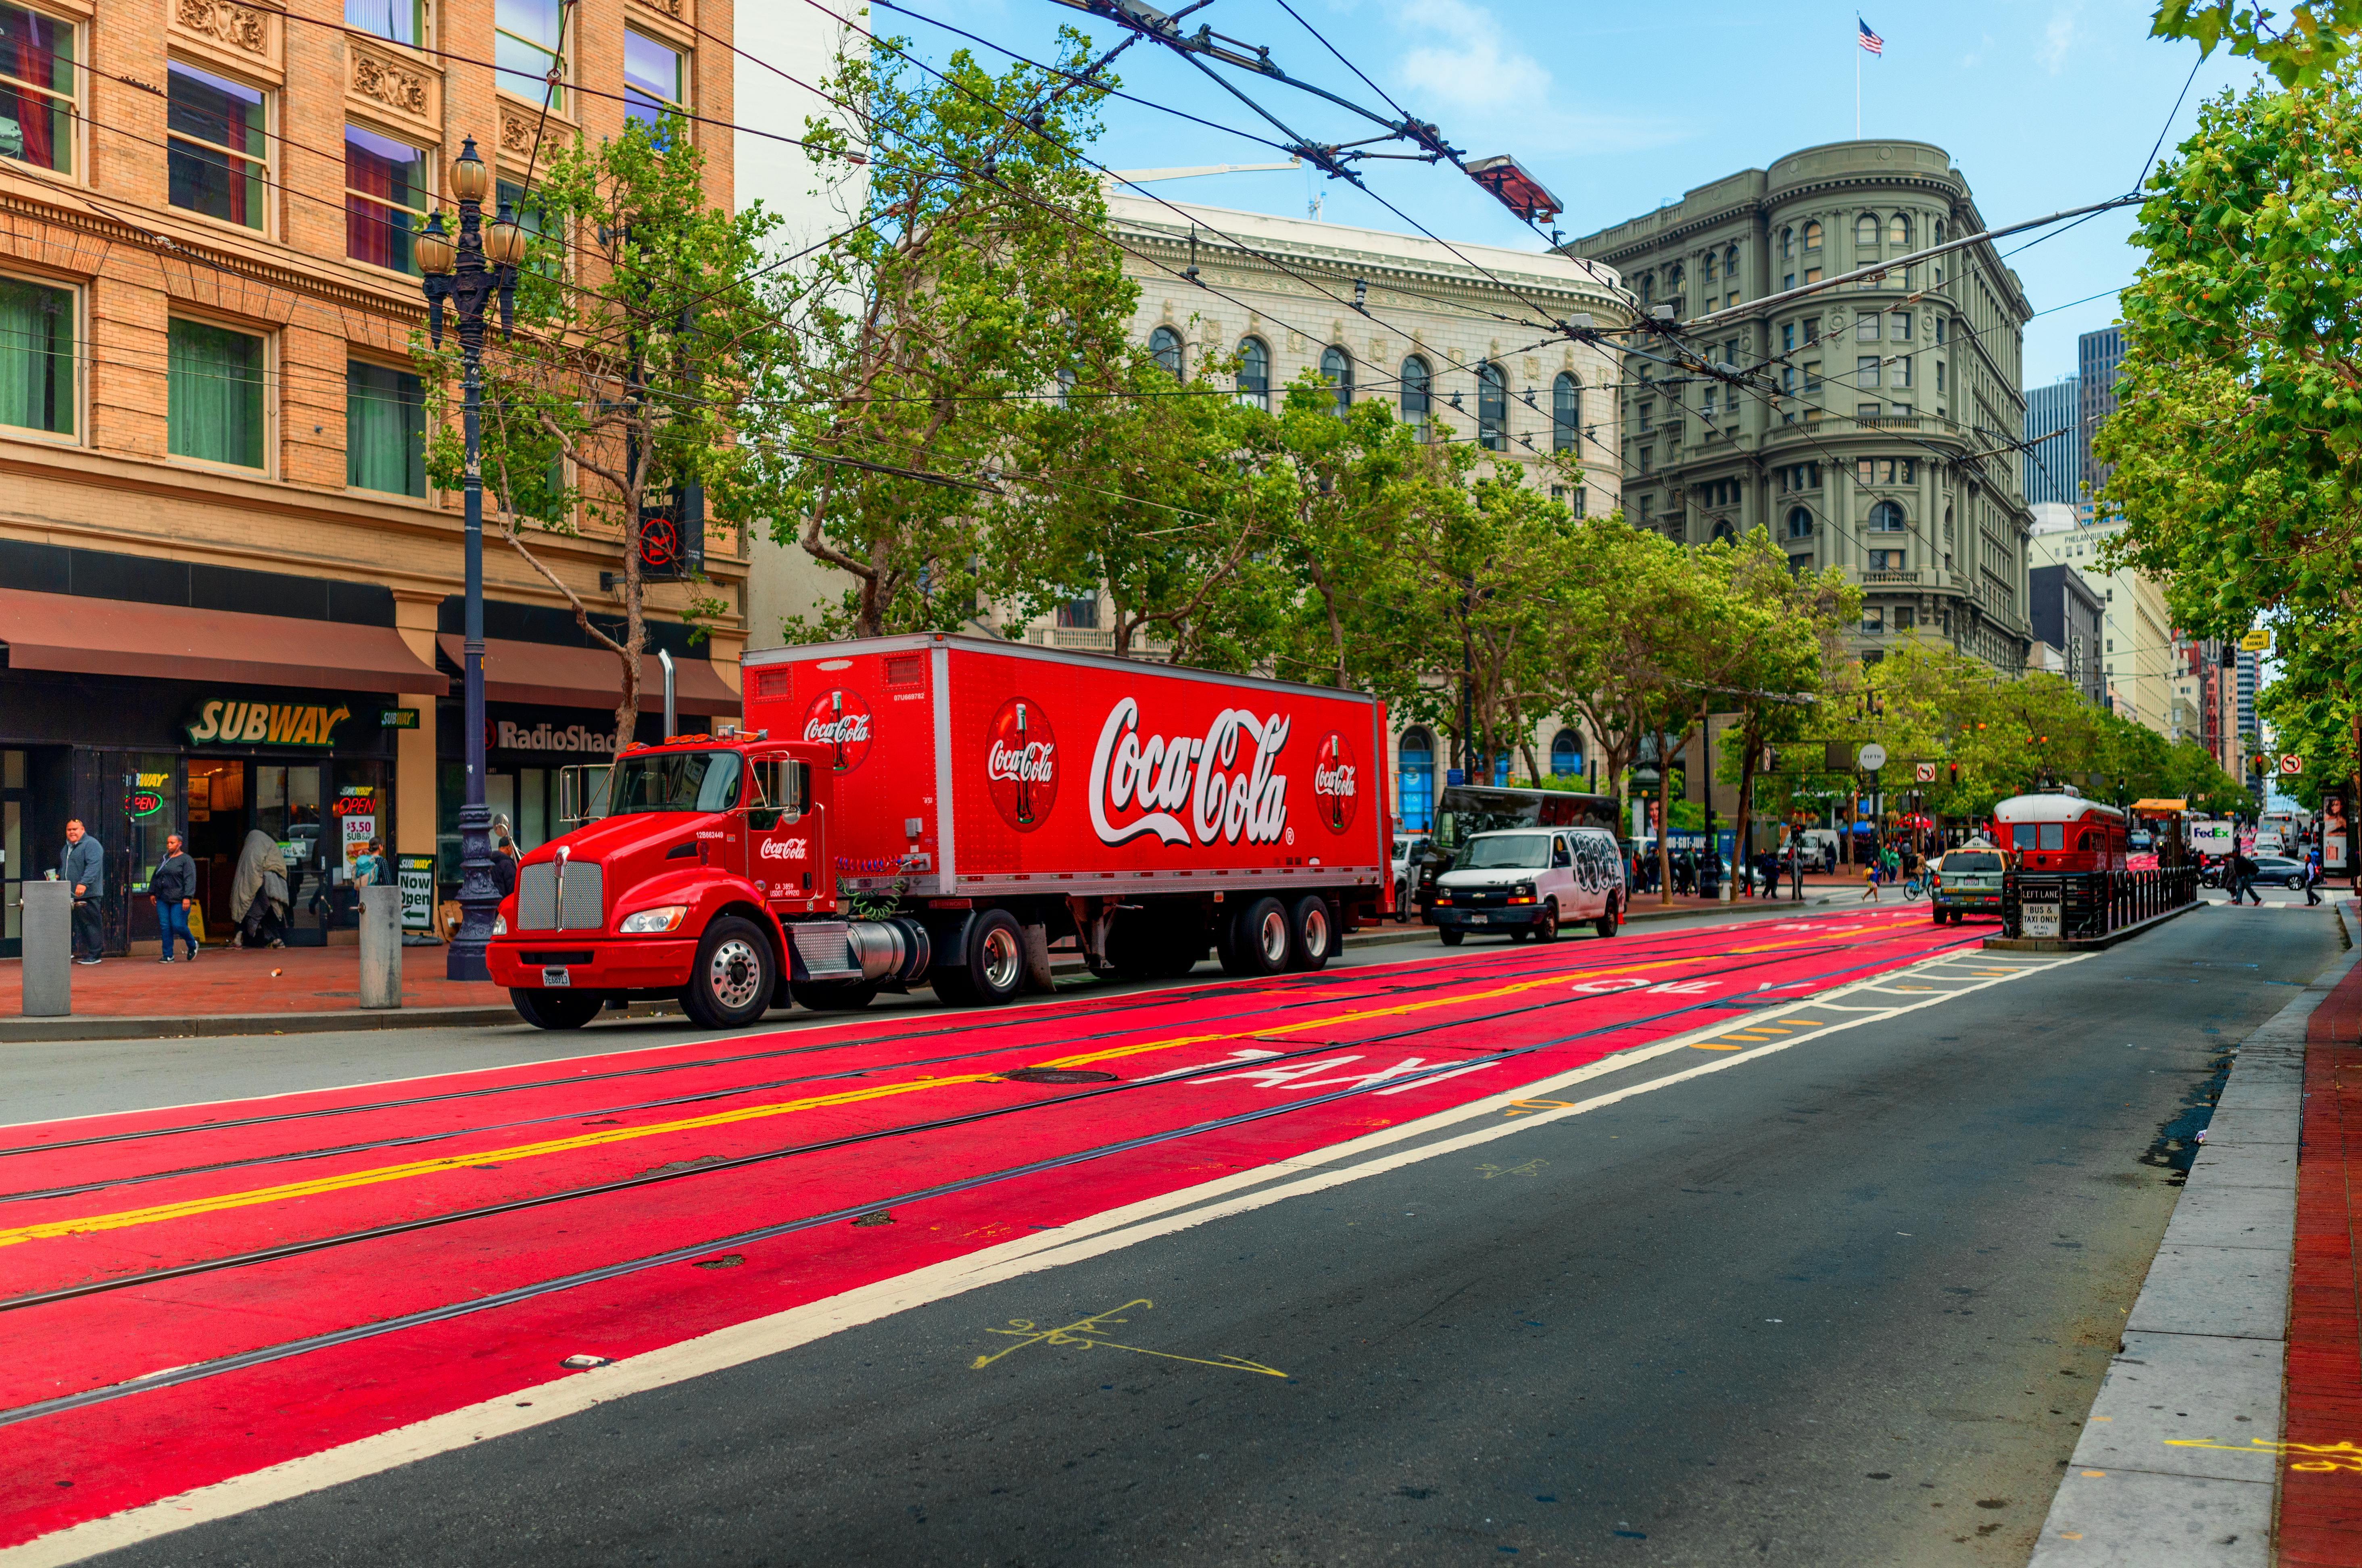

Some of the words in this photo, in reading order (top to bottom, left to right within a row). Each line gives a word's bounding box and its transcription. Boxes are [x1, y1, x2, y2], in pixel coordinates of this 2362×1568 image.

[2065, 534, 2089, 544] PHELAN
[893, 692, 924, 701] 07U669782
[190, 701, 350, 744] SUBWAY
[382, 712, 414, 725] SUBWAY
[804, 714, 870, 743] Coca-Cola
[498, 721, 618, 753] RadioShac
[988, 739, 1054, 782] Coca-Cola
[1089, 697, 1290, 847] Coca-Cola
[1315, 763, 1355, 797] Coca-Cola
[340, 786, 373, 796] SUBWAY
[338, 798, 376, 814] OPEN
[346, 821, 371, 833] $3.50
[2194, 827, 2229, 838] FedEx
[760, 837, 807, 859] Coca-Cola
[399, 859, 432, 869] SUBWAY
[400, 876, 430, 889] Now
[2023, 890, 2039, 899] LEFT
[2041, 890, 2059, 899] LANE
[2030, 906, 2044, 914] BUS
[2047, 906, 2052, 914] &
[544, 975, 568, 985] 9E68913
[1128, 1049, 1502, 1095] TAXI
